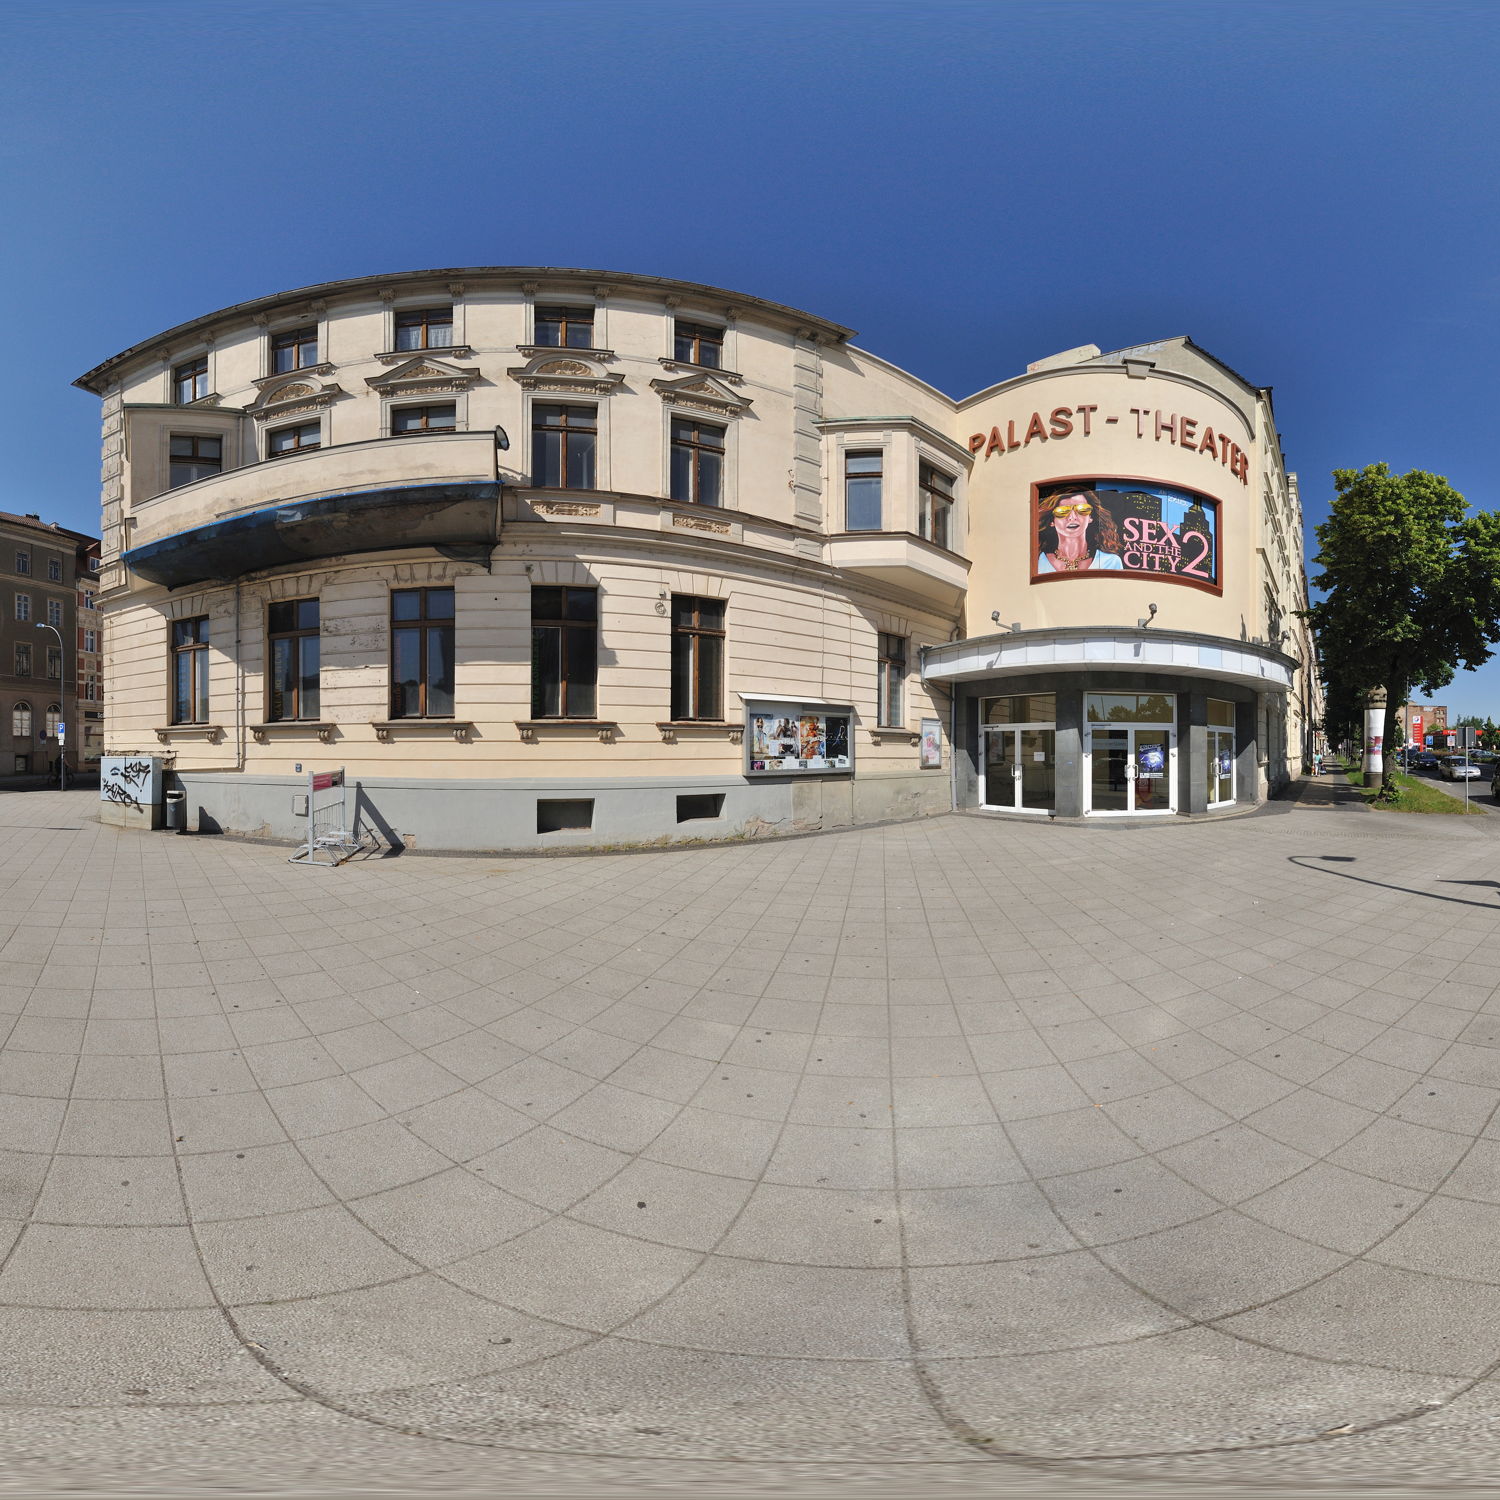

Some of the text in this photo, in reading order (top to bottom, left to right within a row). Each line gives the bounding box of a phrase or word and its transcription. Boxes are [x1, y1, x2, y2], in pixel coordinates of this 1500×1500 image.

[969, 404, 1098, 458] PALAST
[1130, 407, 1249, 486] THEATER
[1123, 517, 1209, 578] SEX 2
[1123, 550, 1181, 573] CITY
[1124, 542, 1182, 557] AND THE
